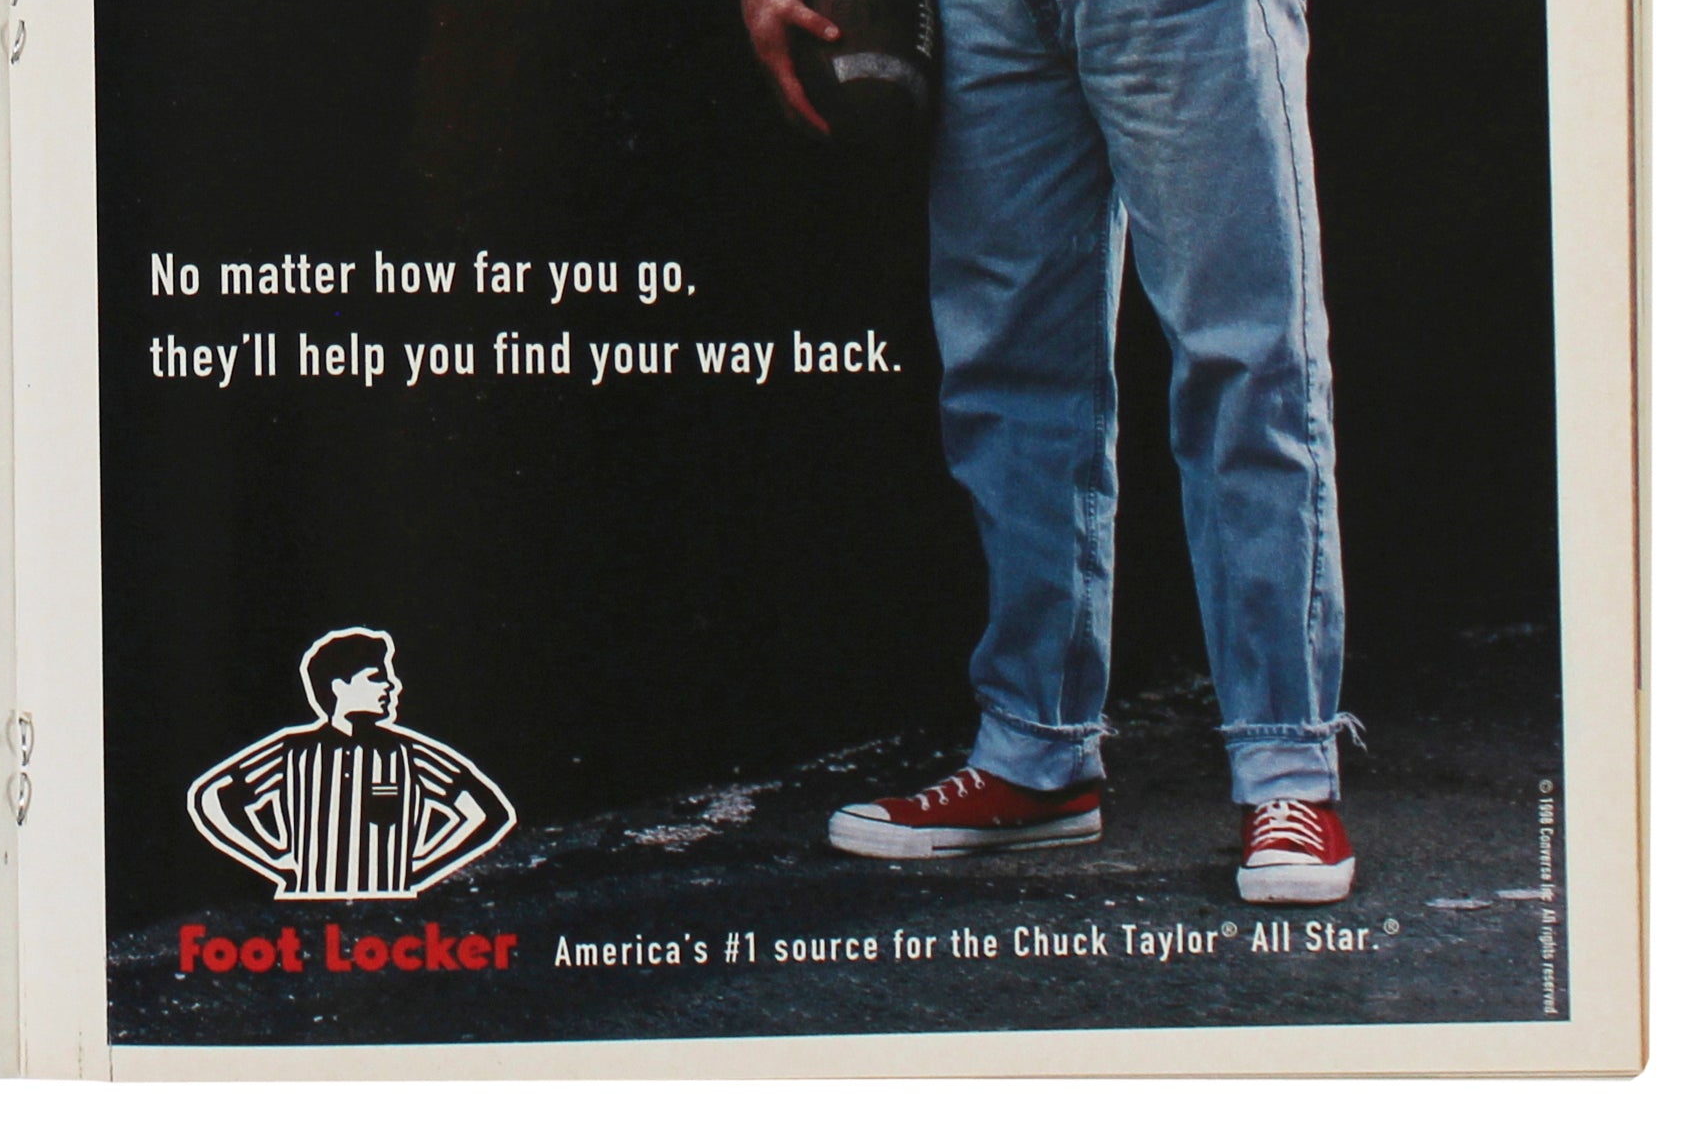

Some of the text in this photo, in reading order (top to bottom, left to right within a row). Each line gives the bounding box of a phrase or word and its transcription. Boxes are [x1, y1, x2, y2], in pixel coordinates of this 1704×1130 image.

[152, 251, 695, 304] No matter how far you go,
[150, 330, 900, 388] they'll help you find your way back.
[178, 921, 518, 973] Foot Locker
[555, 934, 707, 966] America's
[725, 932, 754, 962] #1
[775, 938, 877, 961] source
[893, 929, 936, 958] for
[950, 928, 997, 957] the
[1014, 925, 1107, 956] Chuck
[1251, 921, 1290, 952] All
